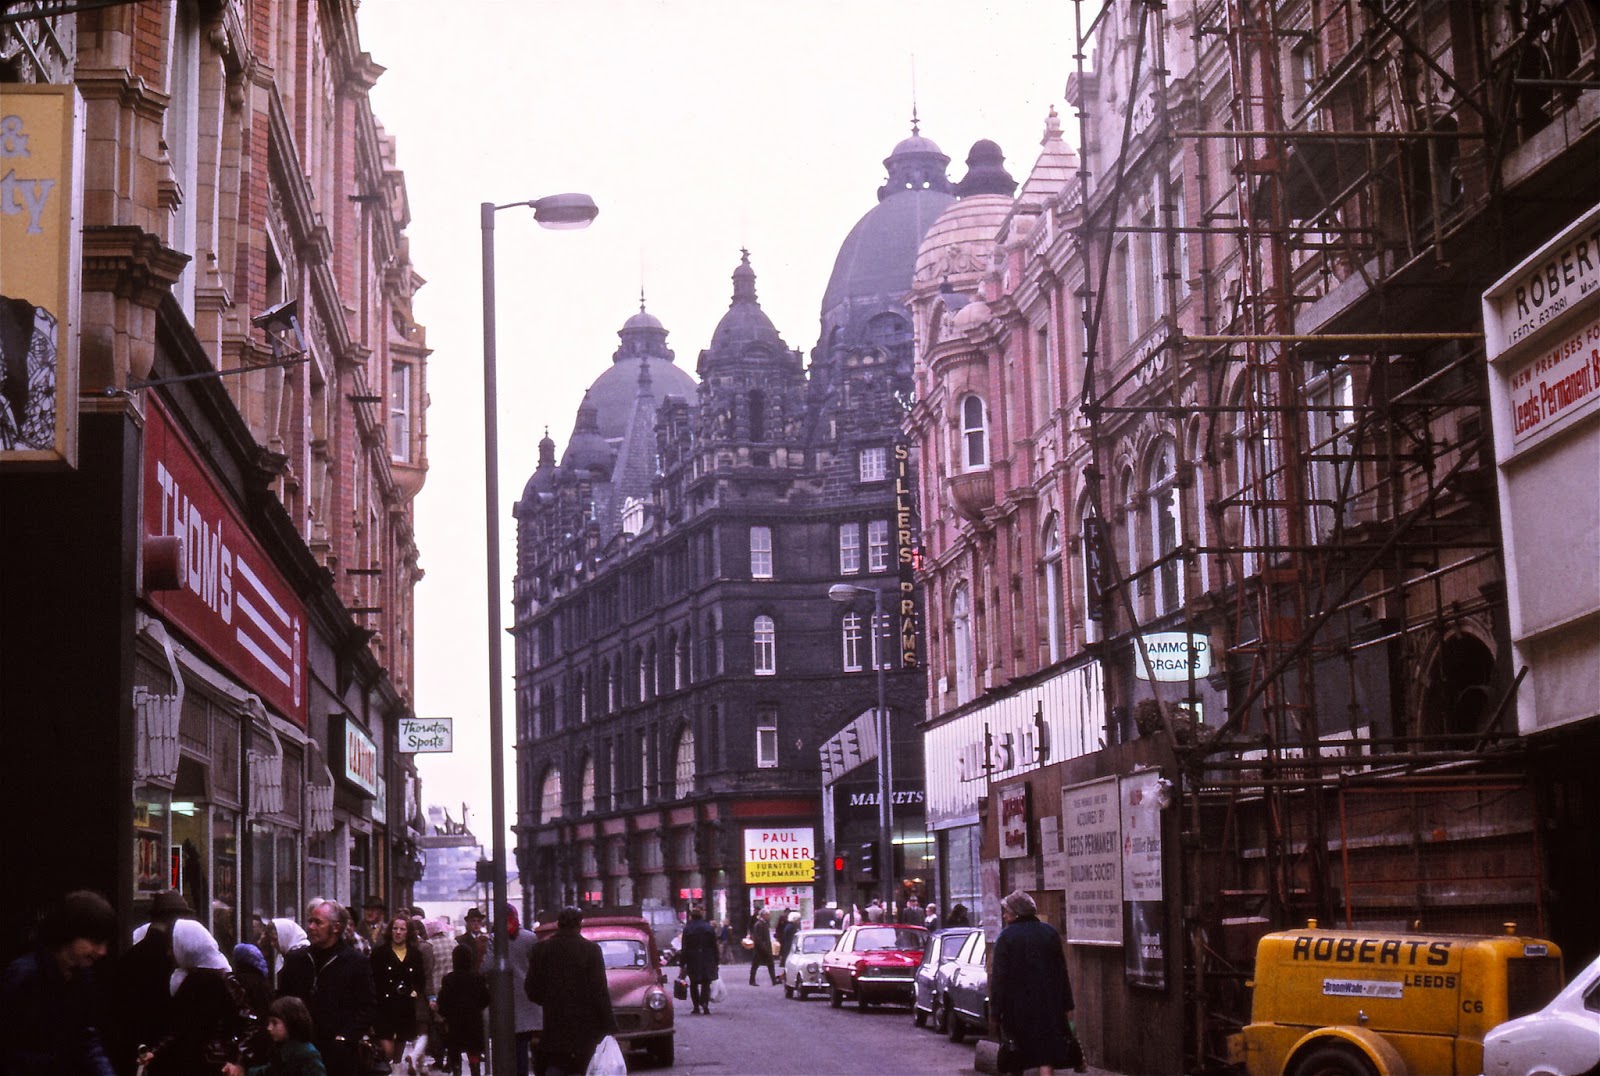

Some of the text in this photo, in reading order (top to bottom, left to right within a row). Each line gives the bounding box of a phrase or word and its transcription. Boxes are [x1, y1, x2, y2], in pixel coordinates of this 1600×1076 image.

[1513, 367, 1532, 391] NEW
[1535, 339, 1583, 377] PREMISES
[1512, 388, 1541, 436] Leeds
[1540, 358, 1593, 420] Permanent
[895, 444, 912, 563] SILLERS
[408, 735, 444, 750] Sports
[762, 832, 798, 842] PAUL
[1067, 830, 1117, 857] LEEDS PERMANENT
[749, 847, 810, 860] TURNER
[750, 869, 810, 878] SUPERMARKET
[757, 862, 802, 870] FURNITURE
[1071, 864, 1093, 882] BUILDING
[1094, 862, 1116, 881] SOCIETY
[1293, 936, 1453, 966] ROBERTS
[1404, 974, 1456, 989] LEEDS
[1462, 1000, 1484, 1014] C6
